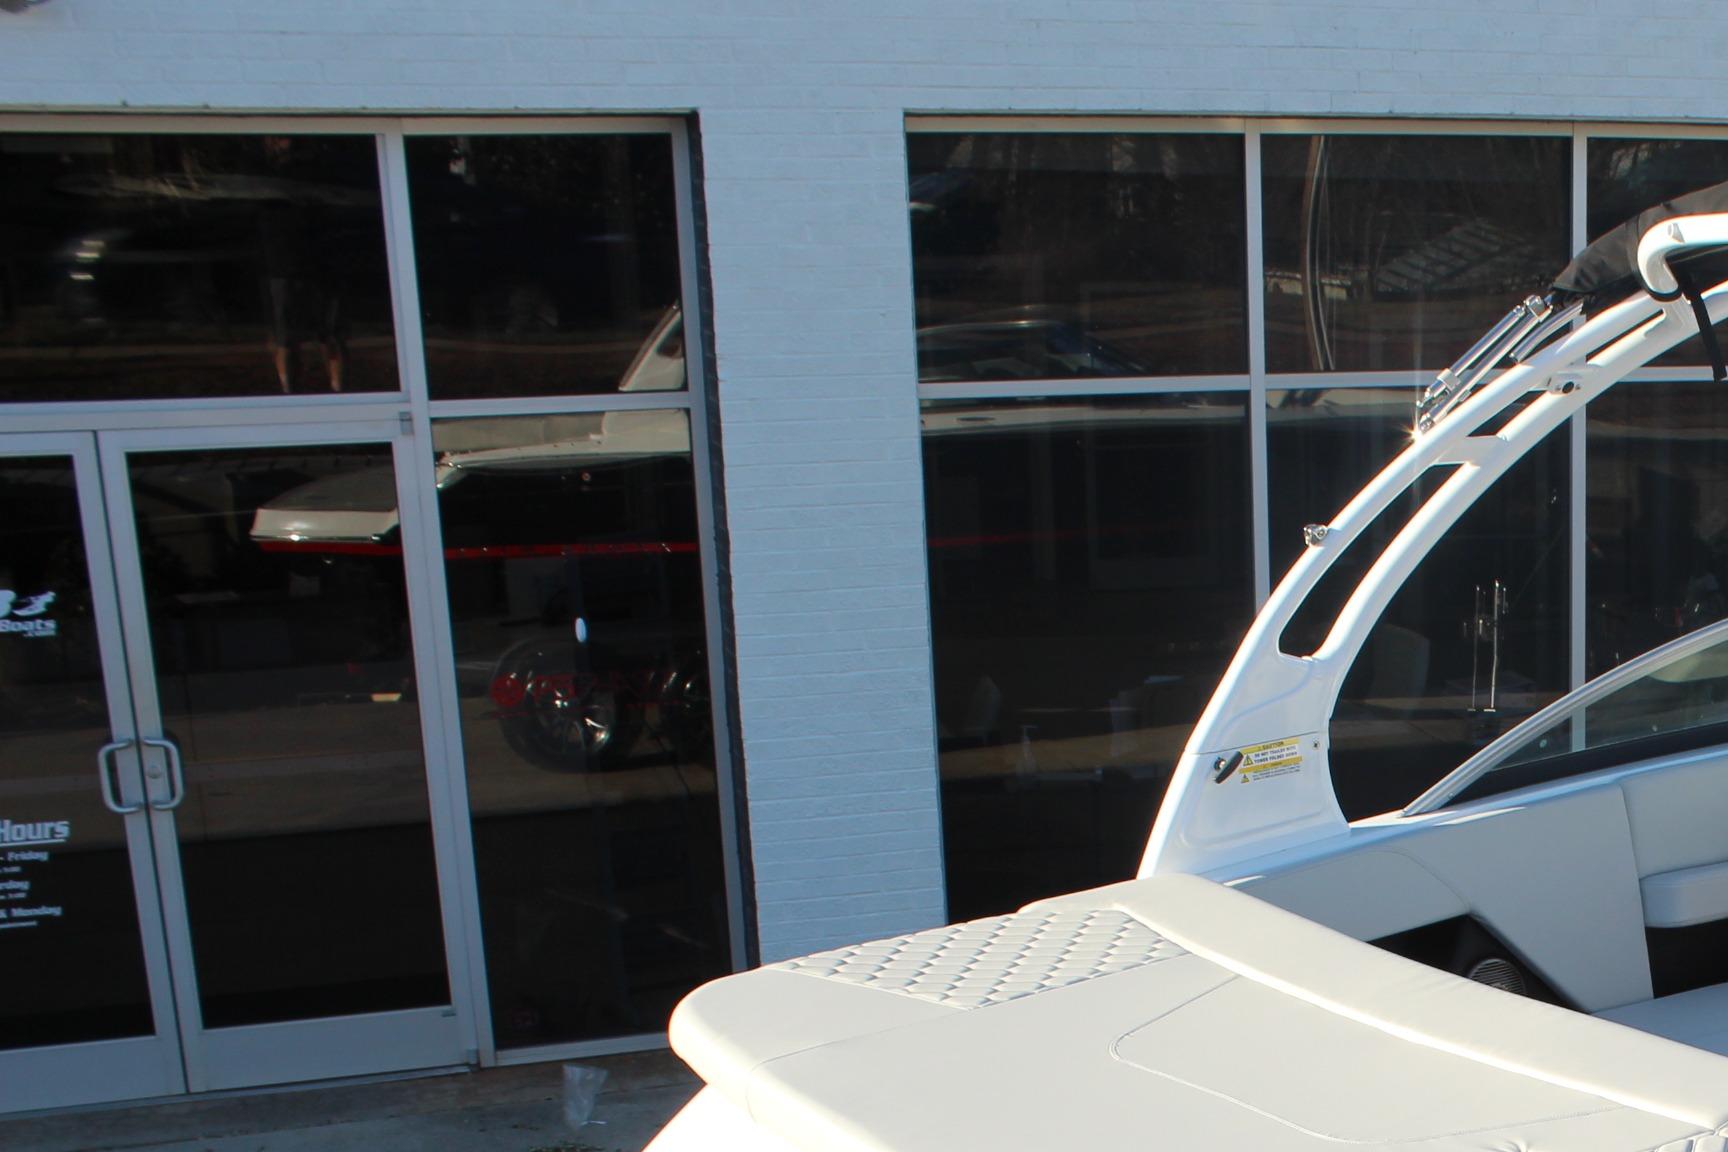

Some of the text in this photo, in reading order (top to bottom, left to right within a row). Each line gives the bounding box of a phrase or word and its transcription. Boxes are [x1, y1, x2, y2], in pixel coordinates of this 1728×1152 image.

[0, 819, 70, 842] Hours
[7, 850, 48, 862] Friday
[11, 905, 62, 917] Monday
